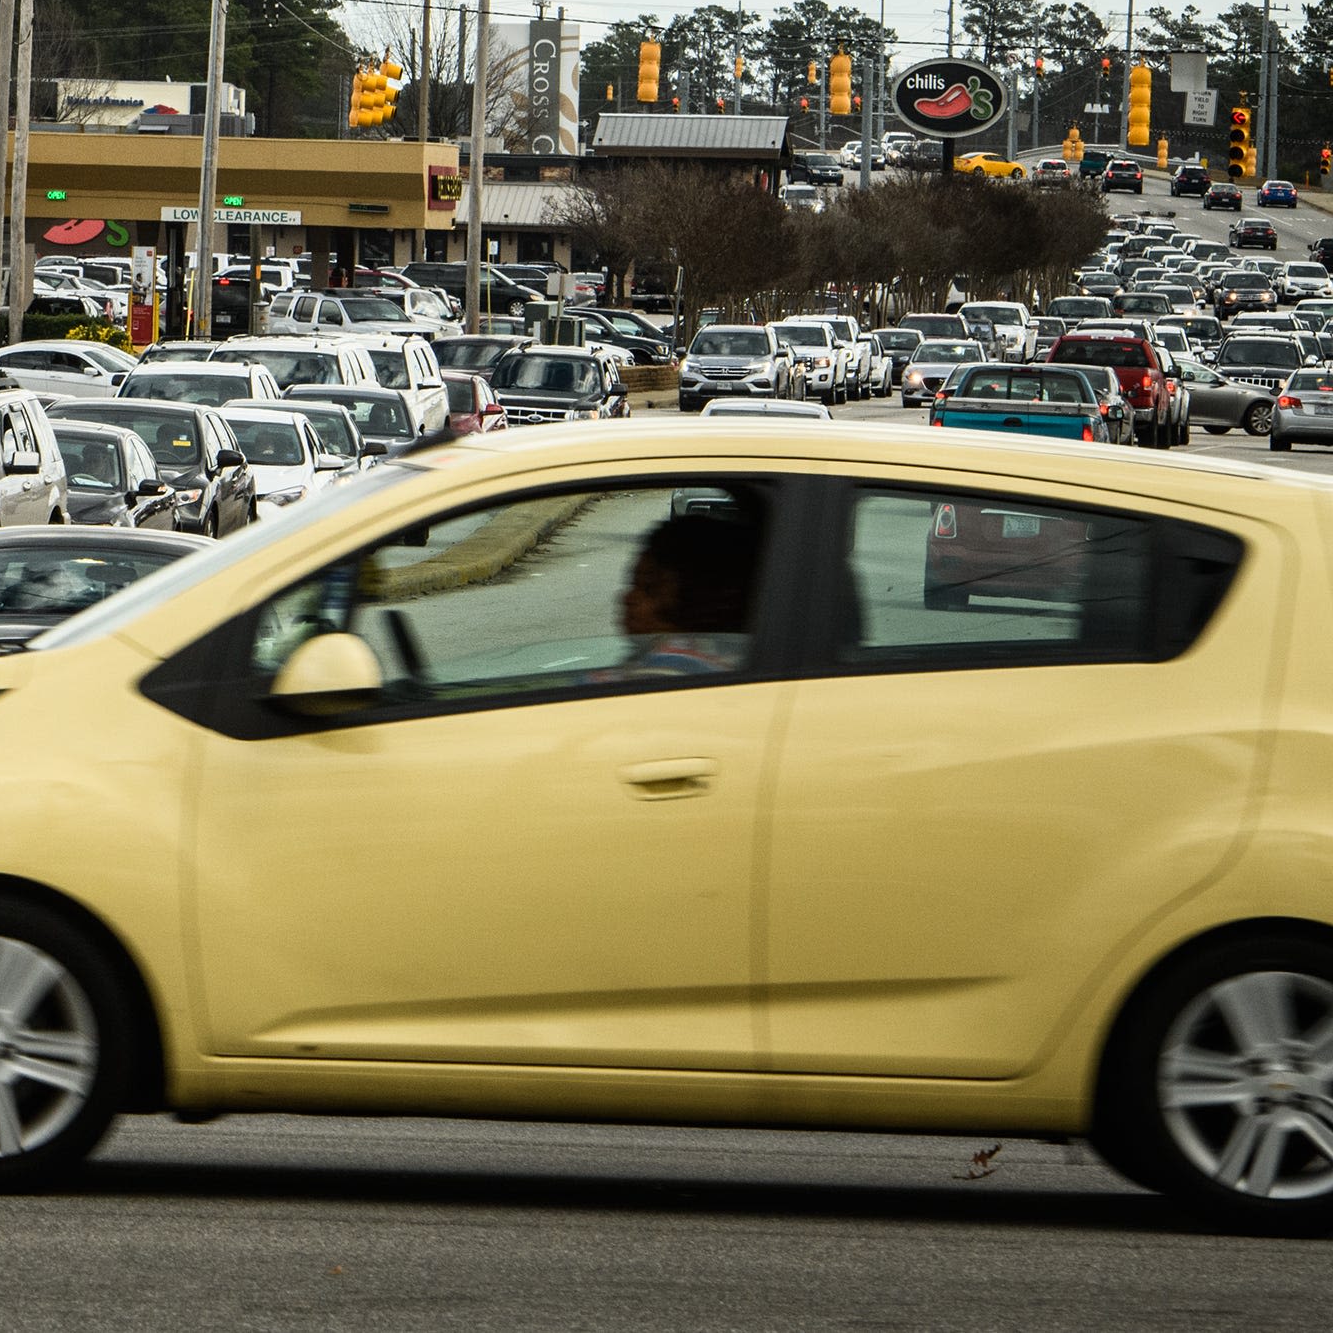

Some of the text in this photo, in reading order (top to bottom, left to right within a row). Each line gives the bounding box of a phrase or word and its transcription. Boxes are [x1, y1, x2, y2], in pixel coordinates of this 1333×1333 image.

[104, 96, 145, 107] America
[47, 191, 66, 200] OPEN
[224, 196, 243, 206] OPEN
[173, 209, 201, 220] LOW
